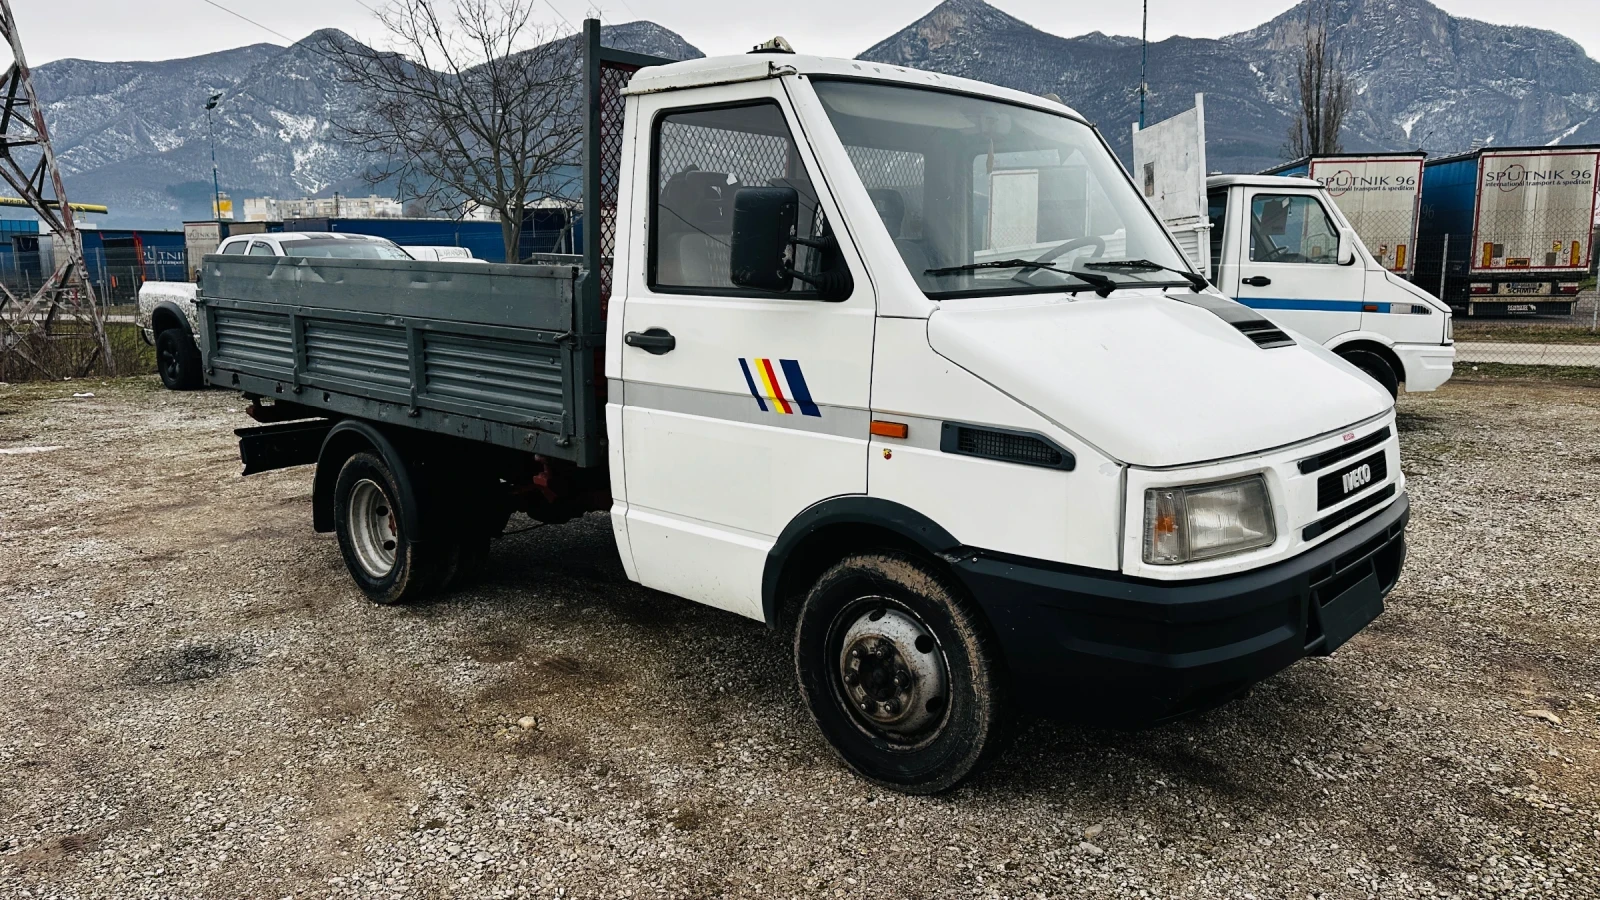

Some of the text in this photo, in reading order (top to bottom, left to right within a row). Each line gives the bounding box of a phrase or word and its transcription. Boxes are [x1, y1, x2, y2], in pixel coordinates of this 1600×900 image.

[1486, 170, 1592, 181] SPUTNIK 96
[1316, 176, 1415, 187] SPUTNIK 96
[1342, 463, 1371, 494] IVECO
